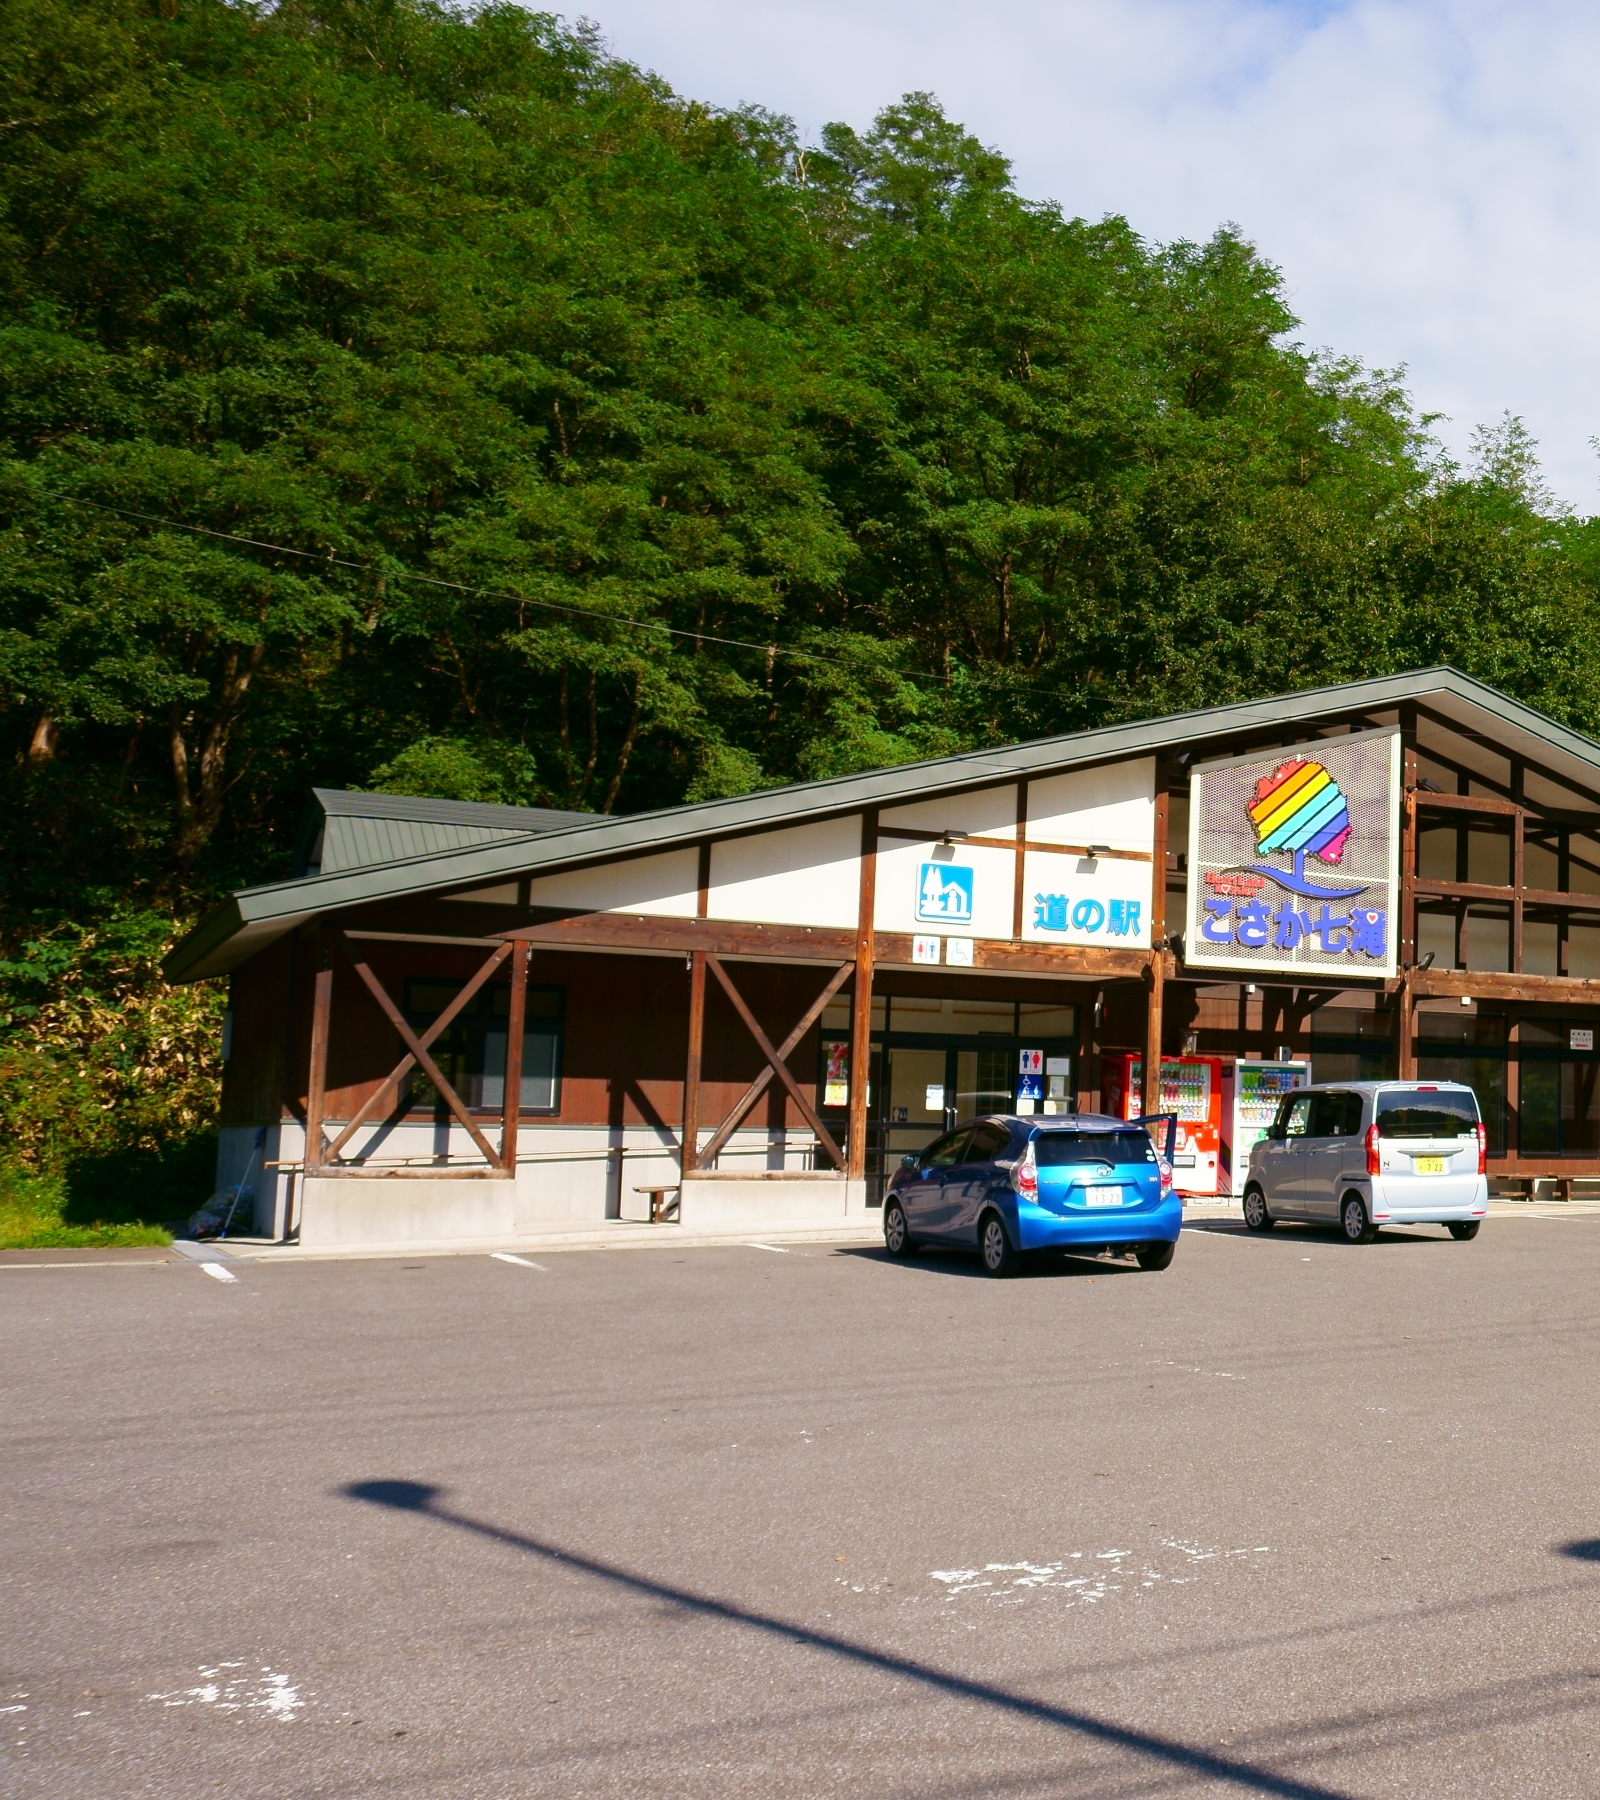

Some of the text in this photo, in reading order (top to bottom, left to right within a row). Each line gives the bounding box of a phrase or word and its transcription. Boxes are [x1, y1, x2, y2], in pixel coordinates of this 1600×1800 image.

[1033, 893, 1141, 937] 道の駅
[1202, 898, 1387, 957] こさか七滝
